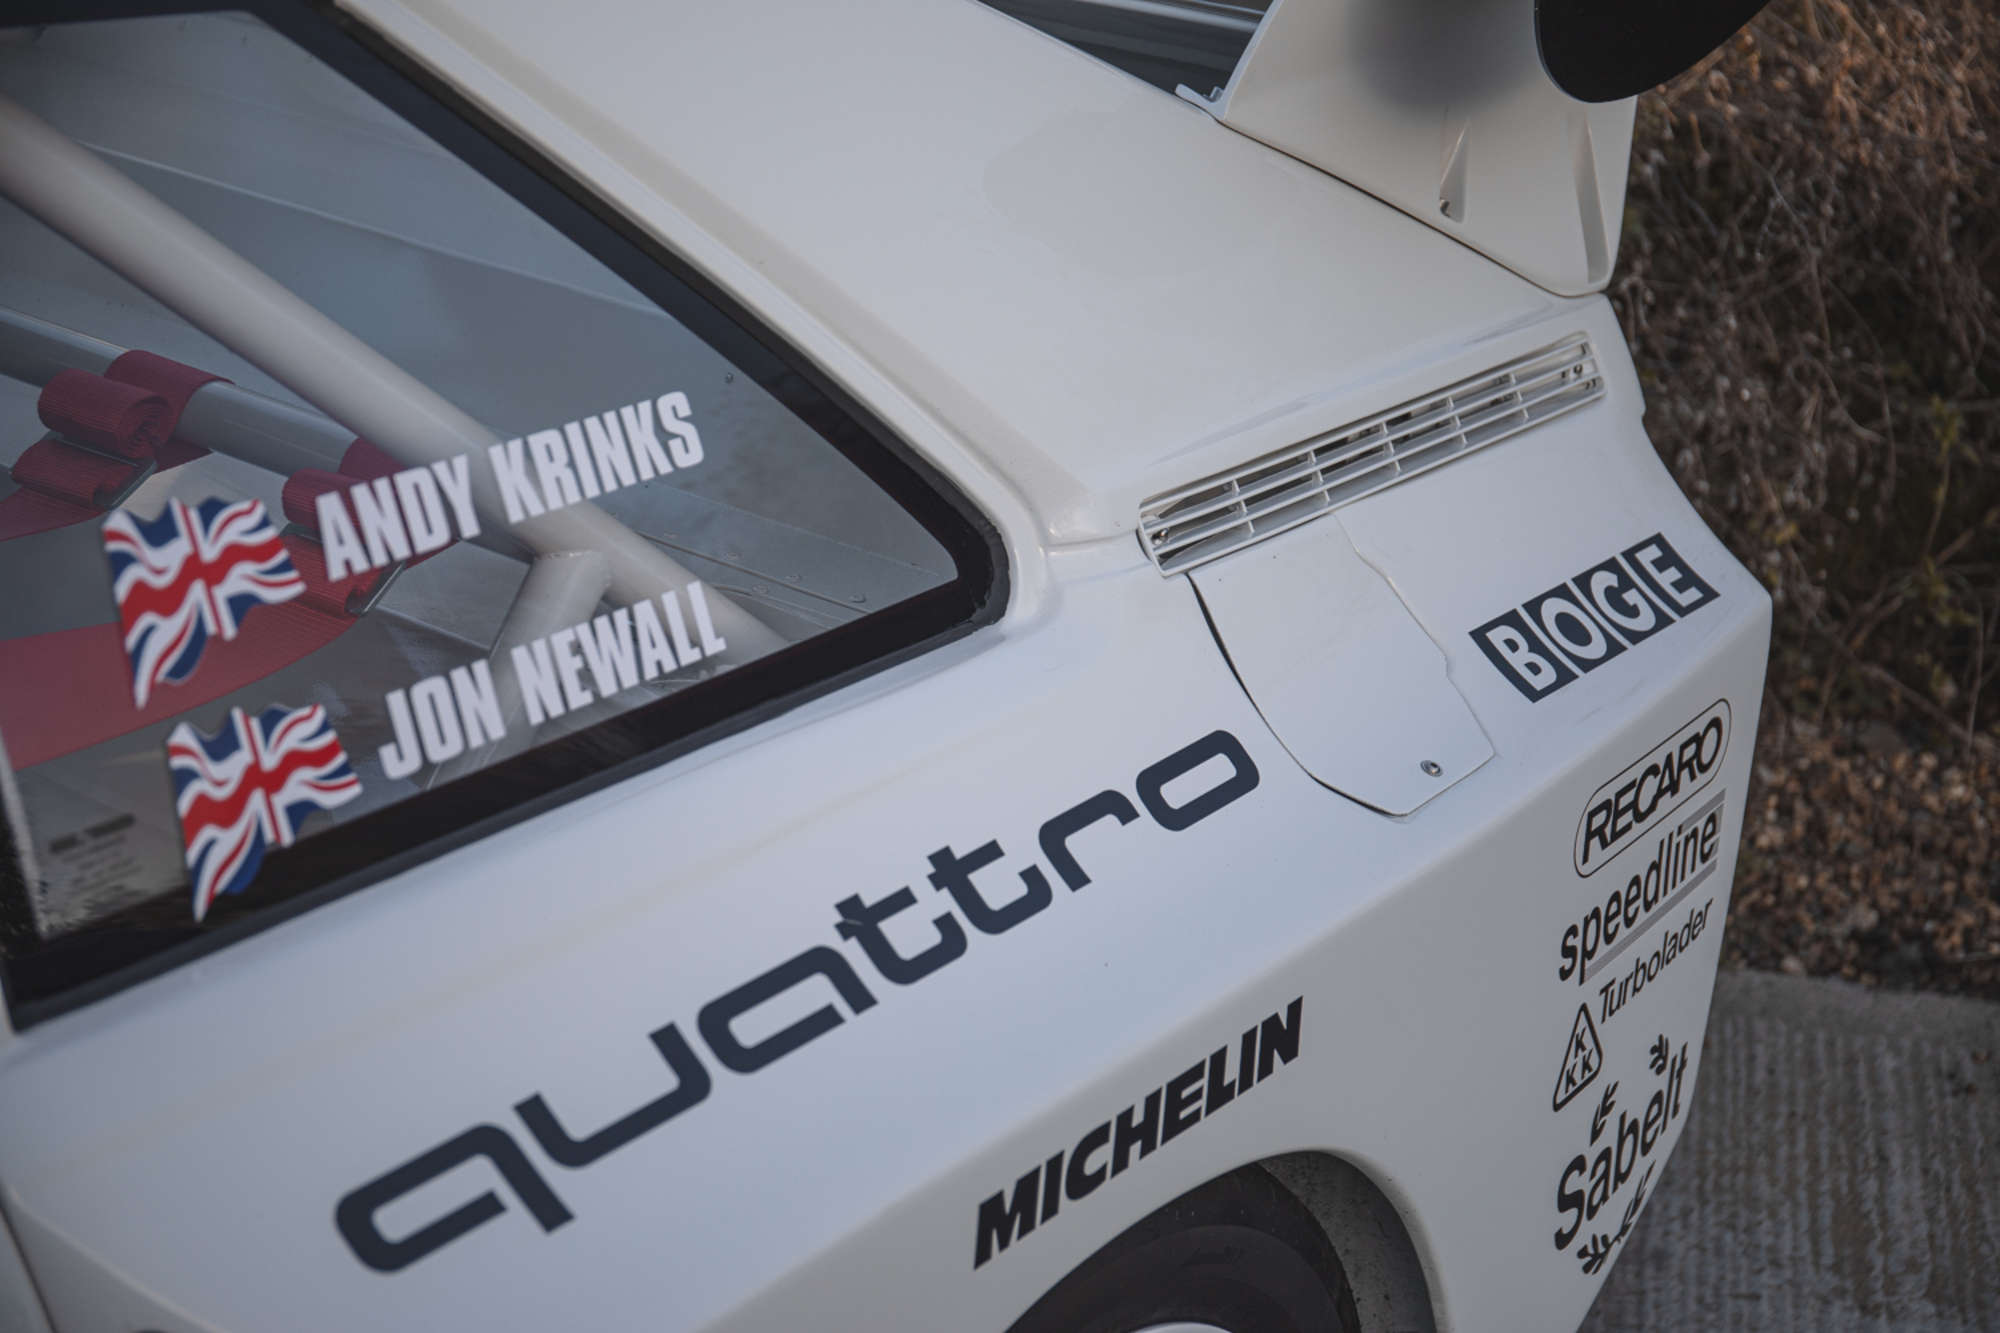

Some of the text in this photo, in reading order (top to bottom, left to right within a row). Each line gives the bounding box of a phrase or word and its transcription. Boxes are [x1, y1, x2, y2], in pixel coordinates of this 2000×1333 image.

[315, 390, 704, 582] ANDY KRINKS
[378, 581, 727, 779] JON NEWALL
[1484, 543, 1705, 692] BOGE
[1582, 716, 1723, 866] RECARO
[1558, 811, 1718, 986] speedline
[1598, 898, 1714, 1024] Turbolader
[334, 730, 1260, 1275] quattro
[973, 996, 1303, 1270] MICHELIN
[1555, 1041, 1689, 1251] Sabelt
